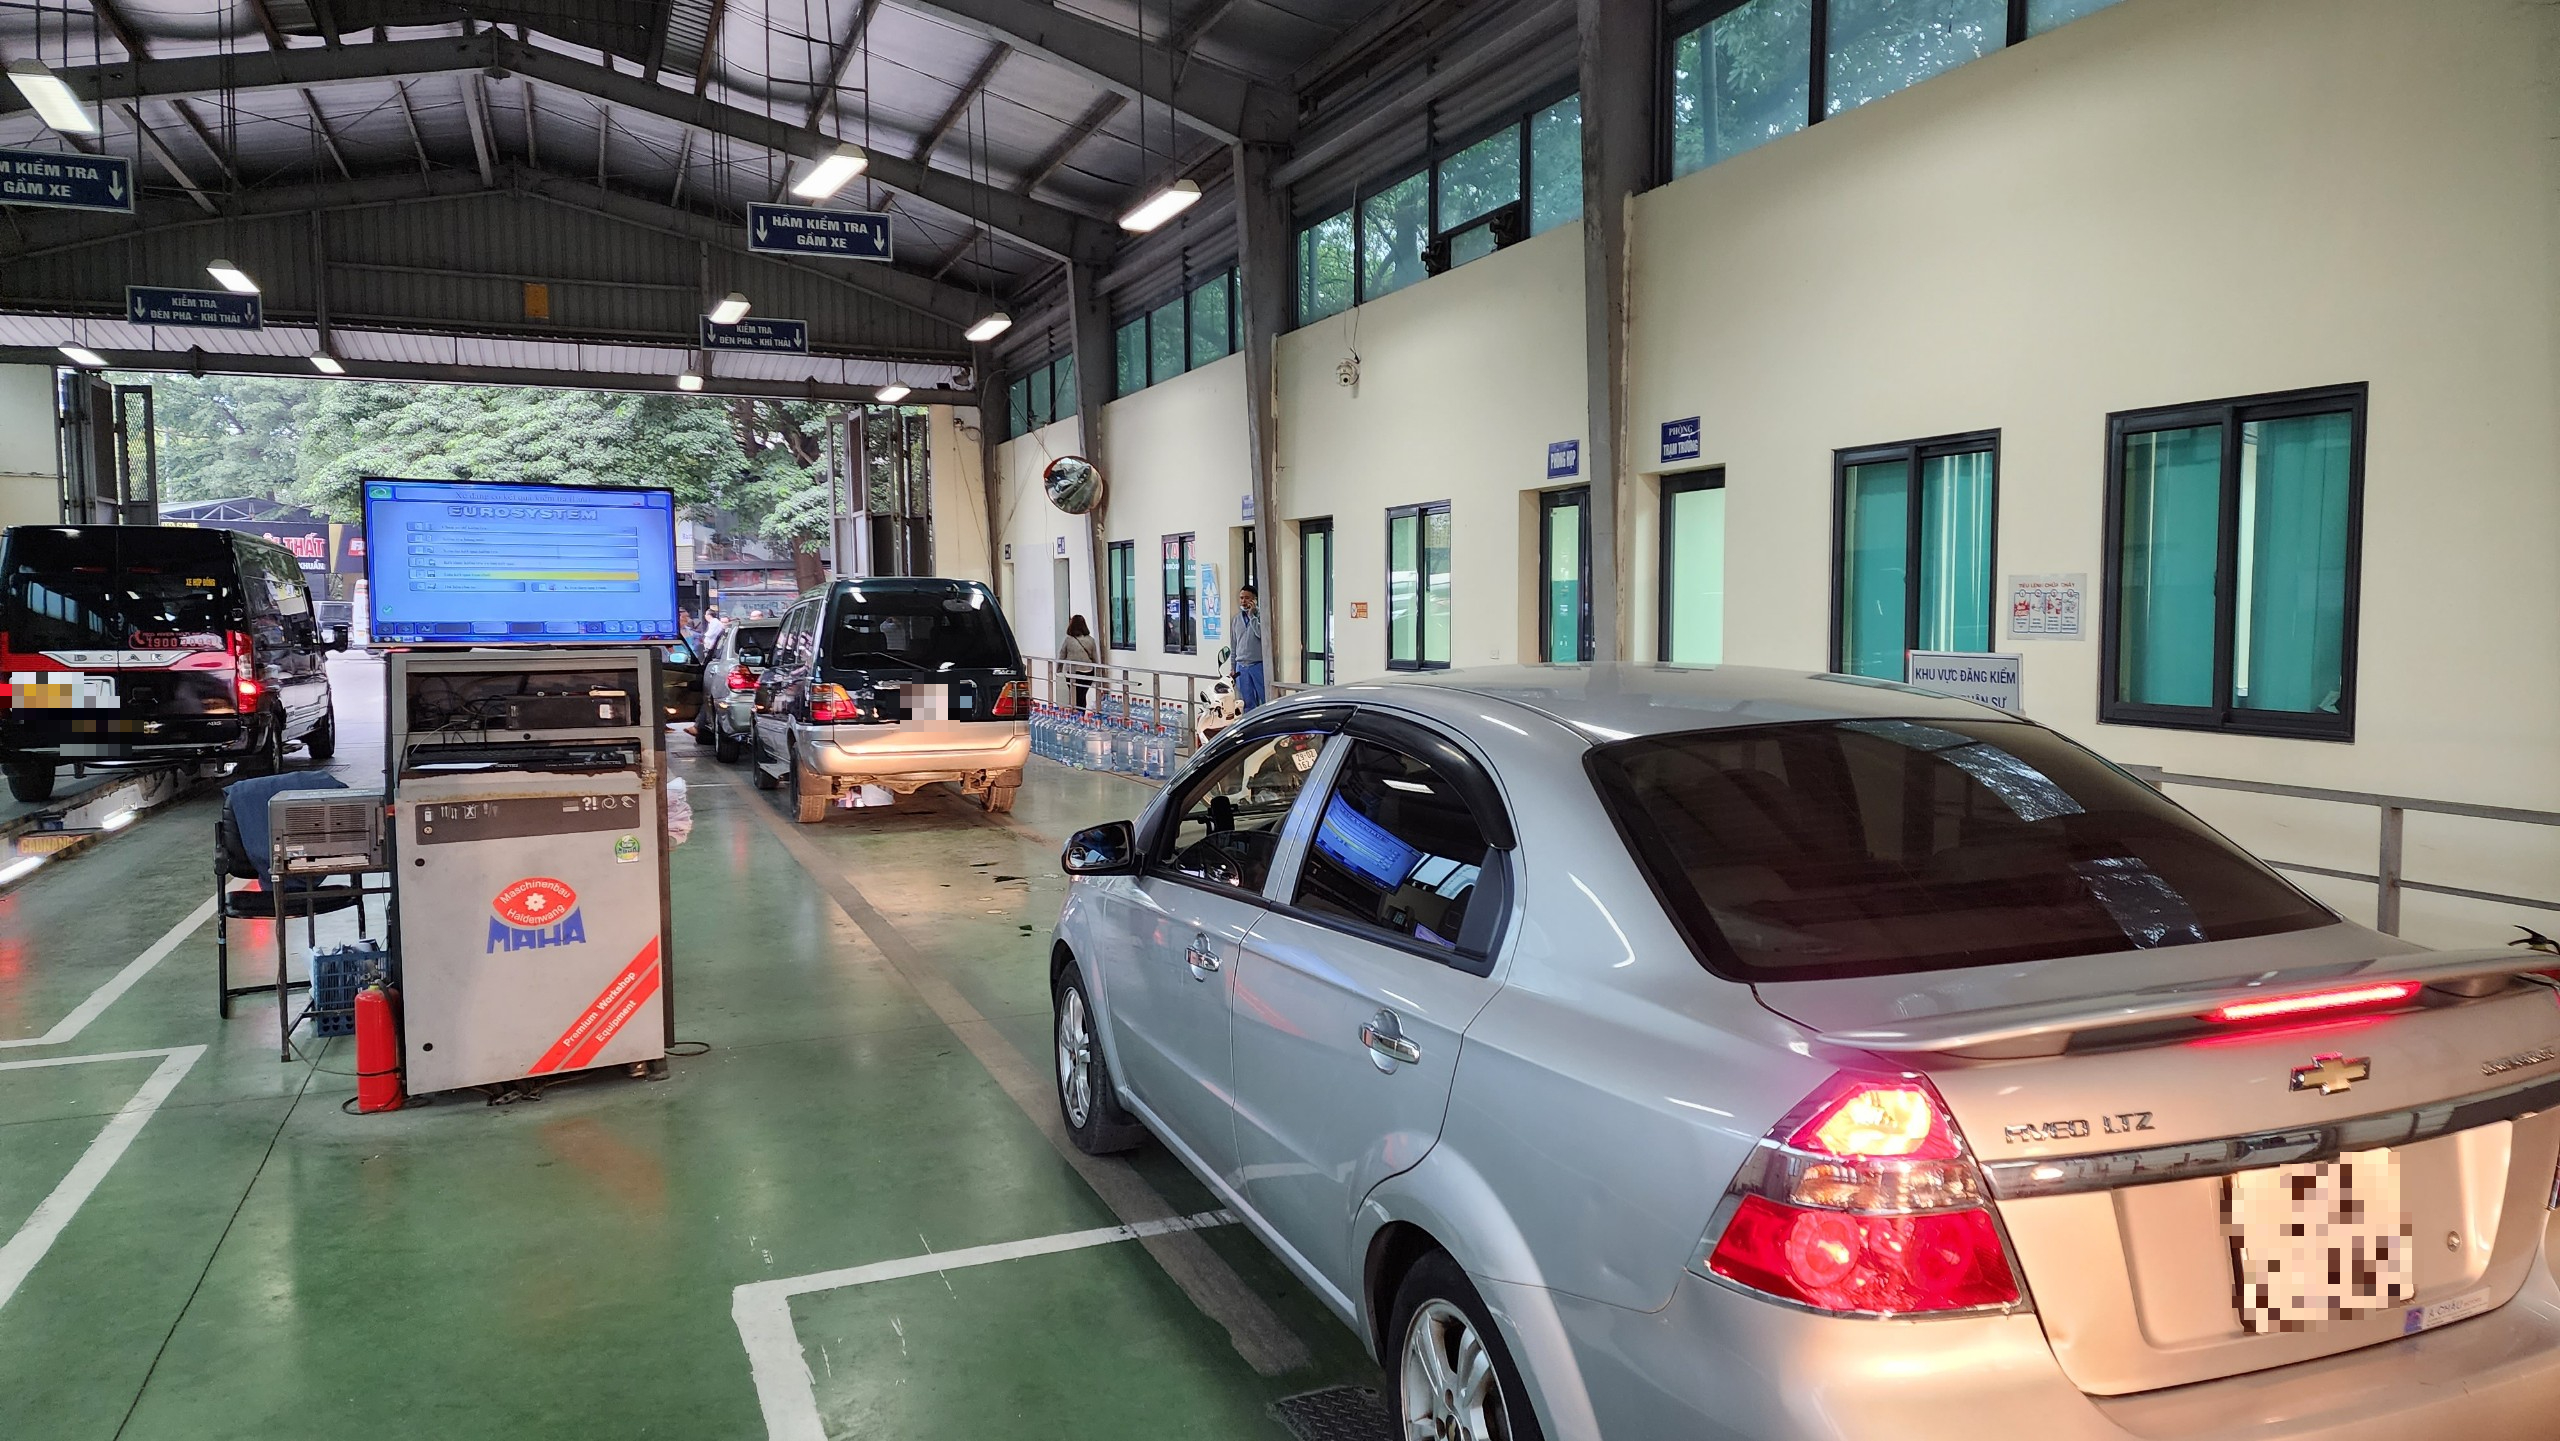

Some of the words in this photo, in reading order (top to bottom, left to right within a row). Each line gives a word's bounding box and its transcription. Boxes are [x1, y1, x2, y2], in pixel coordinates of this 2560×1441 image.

[65, 166, 99, 180] TRA
[3, 177, 43, 195] GẦM
[48, 183, 71, 197] XE
[806, 214, 840, 232] KIỂM
[843, 221, 868, 234] TRA
[796, 231, 827, 247] GẦM
[830, 236, 848, 249] XE
[171, 294, 196, 308] KIỂM
[198, 299, 217, 309] TRA
[150, 308, 170, 320] ĐÈN
[172, 311, 192, 321] PHA
[201, 311, 217, 322] KHÍ
[219, 311, 240, 323] THẢI
[736, 321, 756, 334] KIỂM
[758, 325, 773, 335] TRA
[719, 334, 735, 344] ĐÈN
[737, 336, 753, 346] PHA
[760, 336, 772, 347] KHÍ
[774, 336, 791, 348] THẢI
[1669, 423, 1694, 437] PHÒNG
[447, 504, 598, 520] EUROSYSTEM
[1916, 667, 1936, 681] KHU
[1938, 668, 1958, 684] VỰC
[1960, 667, 1987, 683] ĐĂNG
[1990, 666, 2016, 684] KIỂM
[500, 880, 571, 904] Maschinenbau
[507, 904, 566, 924] Haldenwang
[486, 905, 587, 954] MAHA
[563, 1011, 599, 1047] Premium
[597, 971, 636, 1011] Workshop
[595, 1000, 637, 1042] Equipment
[2005, 1119, 2090, 1144] AVEO
[2103, 1111, 2155, 1134] LTZ
